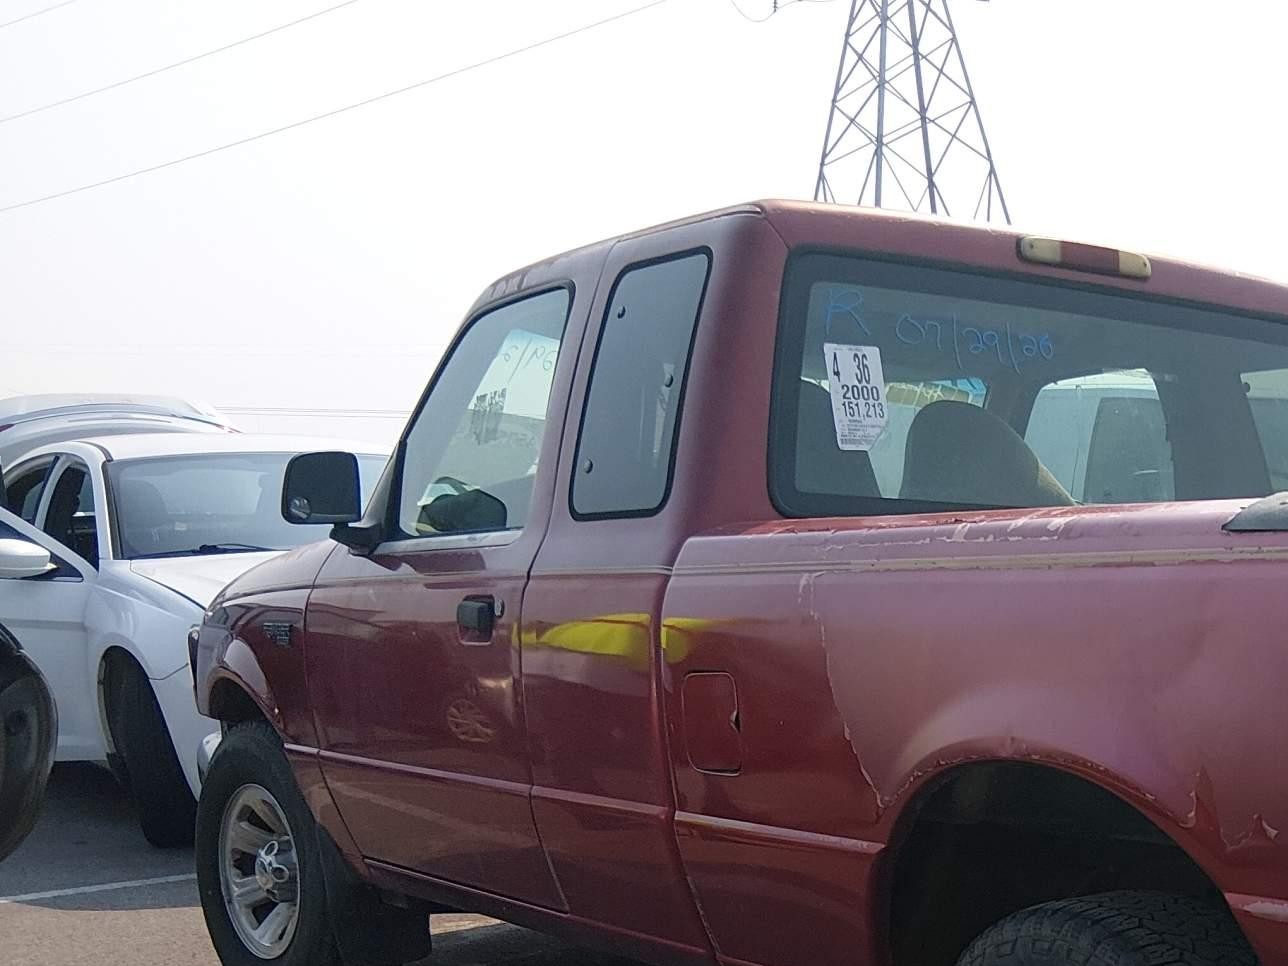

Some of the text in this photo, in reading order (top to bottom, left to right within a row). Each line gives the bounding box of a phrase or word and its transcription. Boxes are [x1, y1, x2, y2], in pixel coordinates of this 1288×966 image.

[824, 288, 871, 337] R
[833, 351, 871, 385] 4 36
[841, 383, 880, 401] 2000
[842, 401, 885, 420] 151,213
